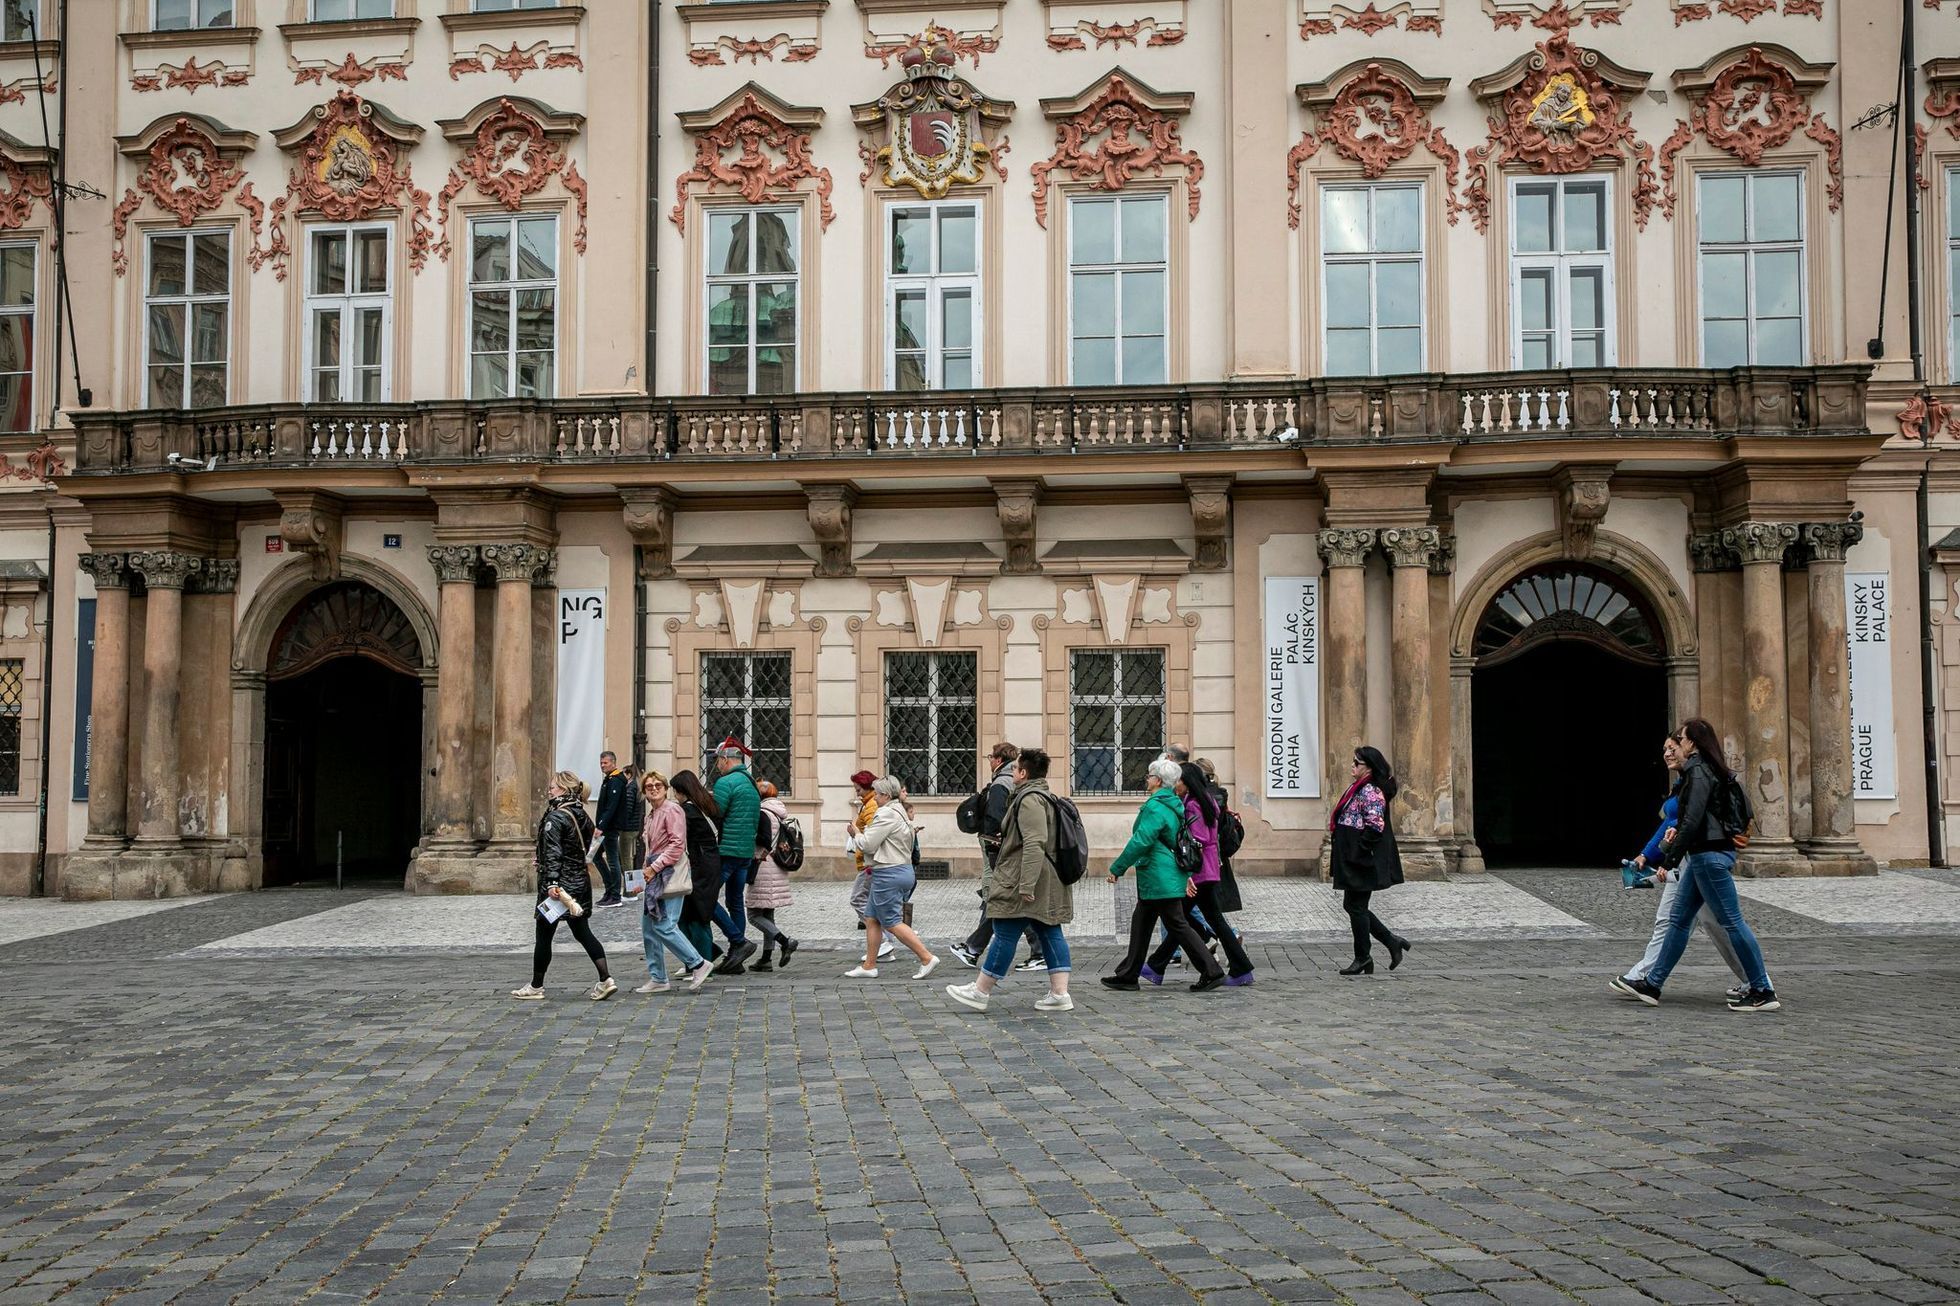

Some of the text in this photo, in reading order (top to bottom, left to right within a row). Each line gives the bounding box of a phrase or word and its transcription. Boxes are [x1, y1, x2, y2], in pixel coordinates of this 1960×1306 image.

[388, 537, 397, 546] 12
[562, 596, 602, 619] NG
[562, 622, 578, 644] P
[1300, 584, 1315, 664] KINSKÝCH
[1854, 583, 1868, 642] KINSKY
[1871, 579, 1885, 642] PALACE
[1284, 612, 1299, 664] PALÁC
[1268, 647, 1284, 789] NÁRODNÍ GALERIE
[1287, 734, 1300, 790] PRAHA
[1858, 724, 1874, 791] PRAGUE
